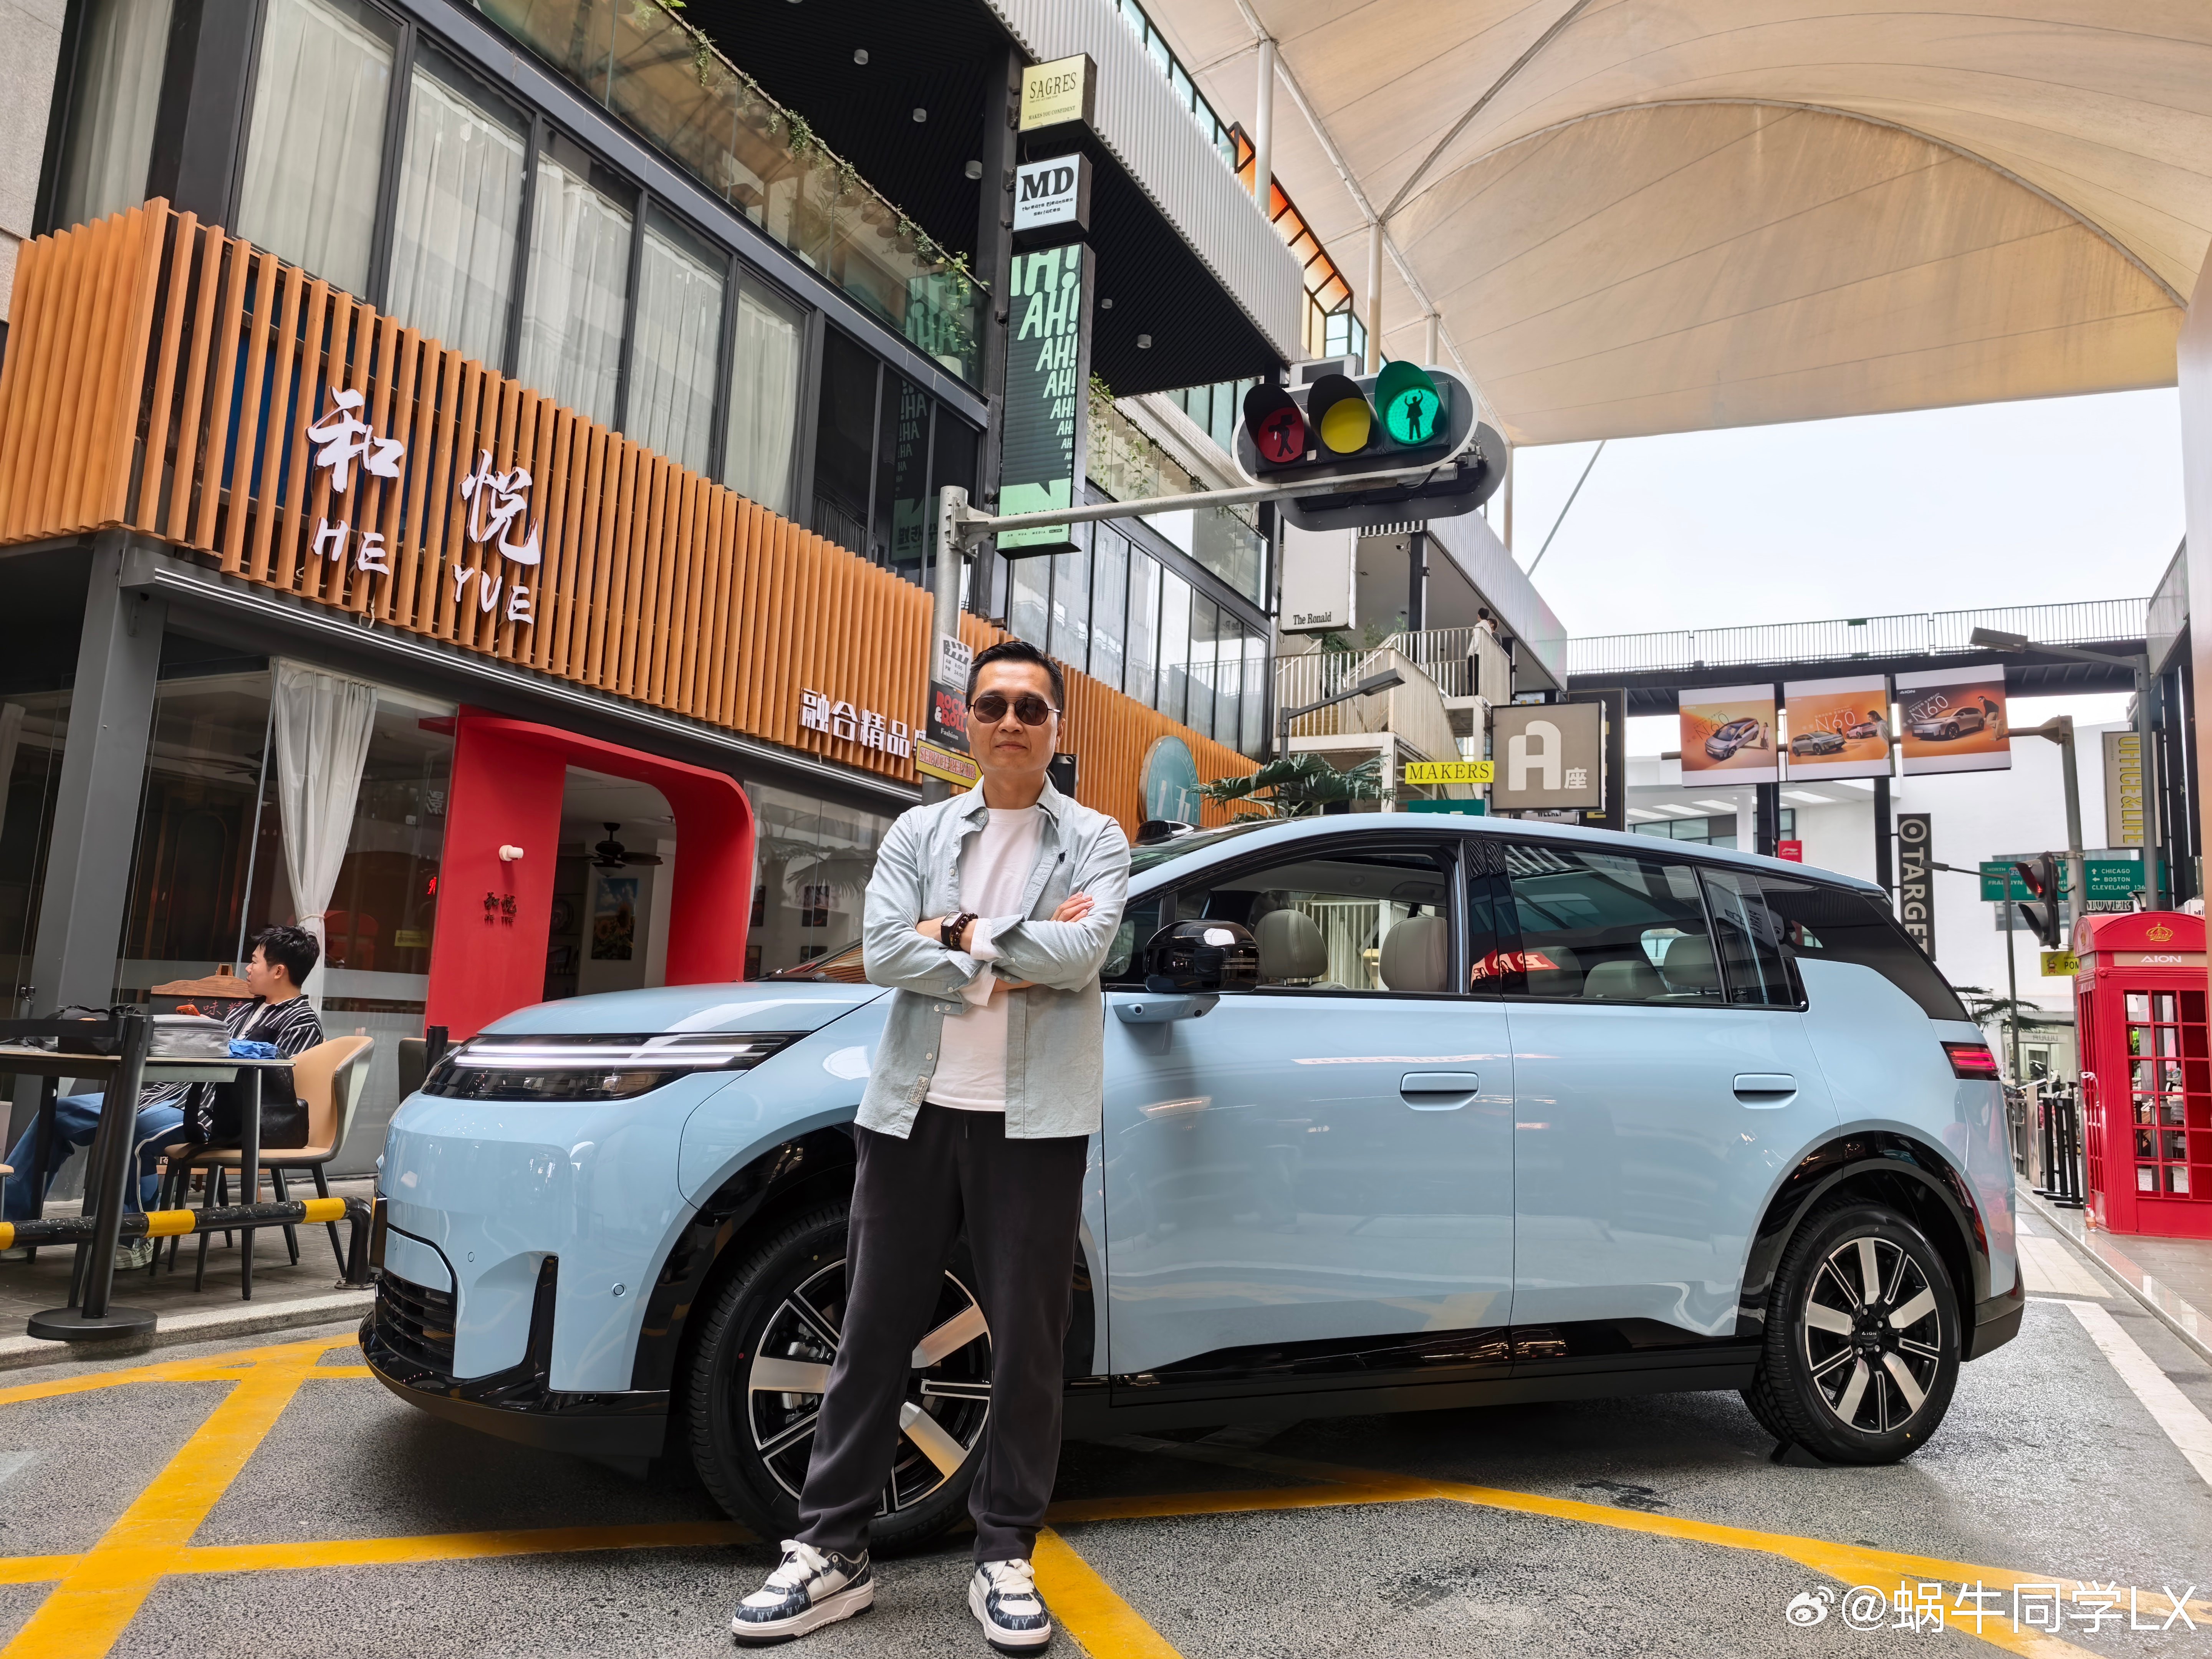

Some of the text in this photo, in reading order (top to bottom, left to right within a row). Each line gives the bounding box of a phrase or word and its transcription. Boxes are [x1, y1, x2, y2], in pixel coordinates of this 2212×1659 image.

[1030, 72, 1076, 99] SAGRES
[1051, 106, 1076, 115] CONFIDENT
[1019, 167, 1074, 202] MD
[1017, 283, 1080, 340] AH!
[1035, 333, 1078, 371] AH!
[1043, 367, 1075, 398] AH!
[1050, 396, 1075, 419] AH!
[305, 386, 540, 565] 和悦
[310, 517, 533, 625] HE YUE
[1293, 612, 1331, 625] The Ronald
[936, 690, 966, 717] ROCK
[1911, 695, 1948, 722] N60
[941, 728, 959, 740] Fashion
[1815, 711, 1855, 731] N60
[919, 746, 976, 780] SERVICE REPAIR
[1409, 763, 1489, 779] MAKERS
[1902, 847, 1927, 954] TARGET
